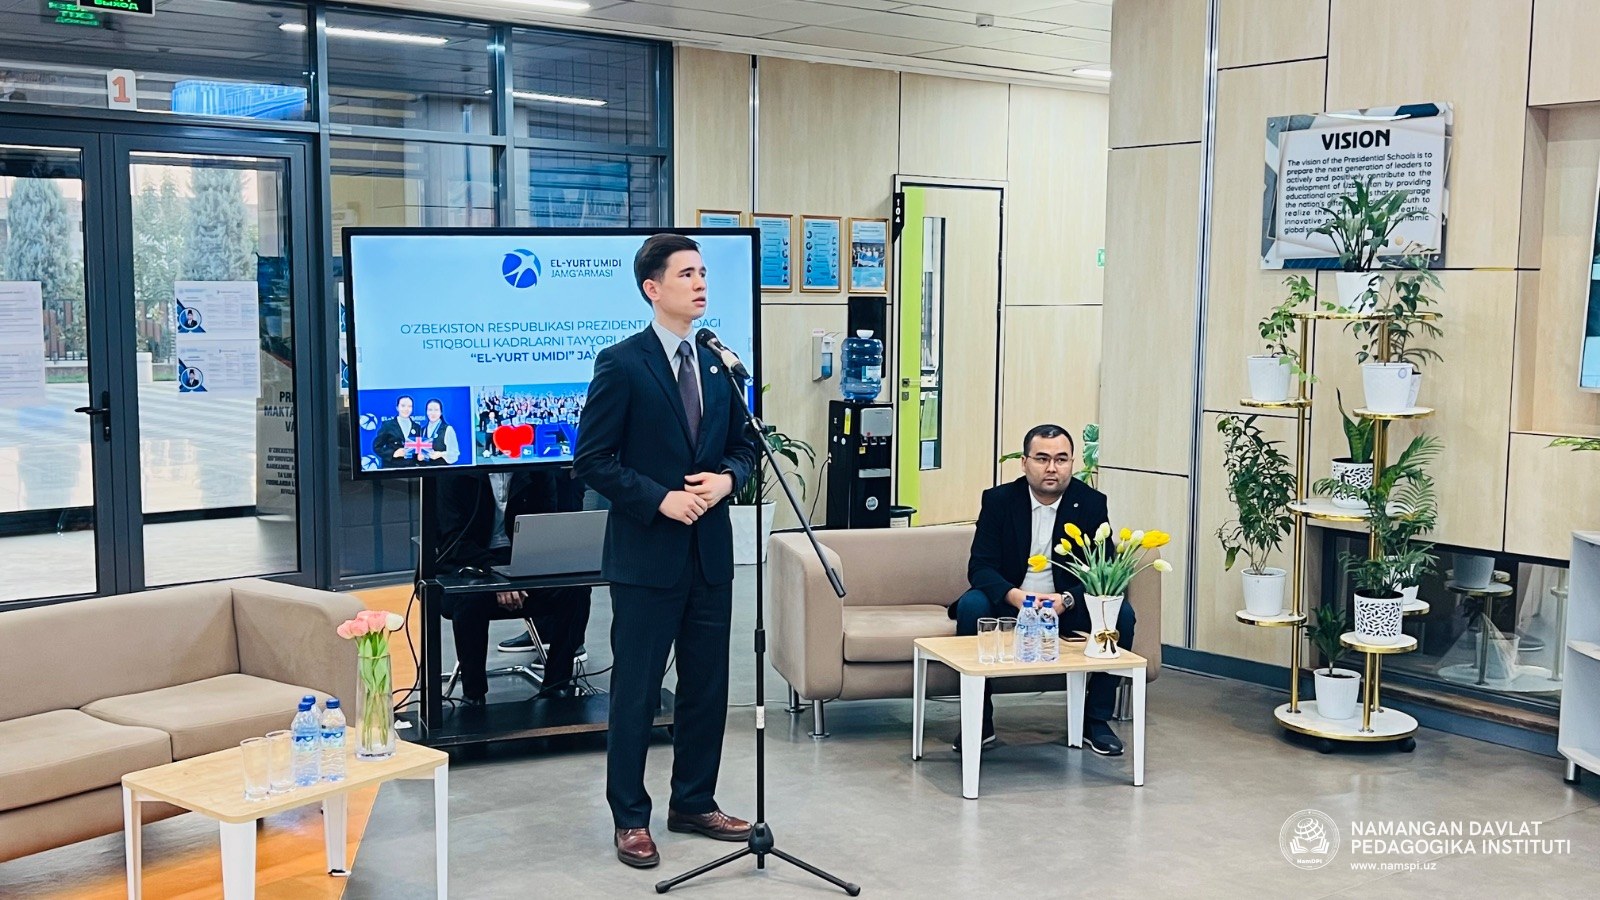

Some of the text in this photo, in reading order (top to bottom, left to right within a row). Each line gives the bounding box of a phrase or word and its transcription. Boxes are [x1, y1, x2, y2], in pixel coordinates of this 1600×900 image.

[112, 76, 131, 103] 1
[1321, 129, 1390, 150] VISION
[1344, 154, 1385, 163] Presidential
[1387, 152, 1415, 160] Schools
[1286, 168, 1313, 176] prepare
[1345, 163, 1383, 173] generation
[1395, 161, 1422, 169] leaders
[1286, 175, 1312, 183] actively
[1332, 172, 1364, 181] positively
[1367, 171, 1405, 179] contribute
[1286, 183, 1330, 191] development
[1385, 180, 1393, 188] by
[1397, 178, 1431, 187] providing
[1285, 192, 1326, 200] educational
[1298, 200, 1325, 208] nation's
[1284, 226, 1304, 235] global
[551, 259, 622, 268] EL-YURT UMIDI
[551, 269, 613, 278] JAMG'ARMASI
[400, 323, 484, 335] O'ZBEKISTON
[488, 321, 574, 333] RESPUBLIKASI
[577, 319, 646, 331] PREZIDENTI
[423, 338, 490, 350] ISTIQBOLLI
[493, 336, 564, 348] KADRLARNI
